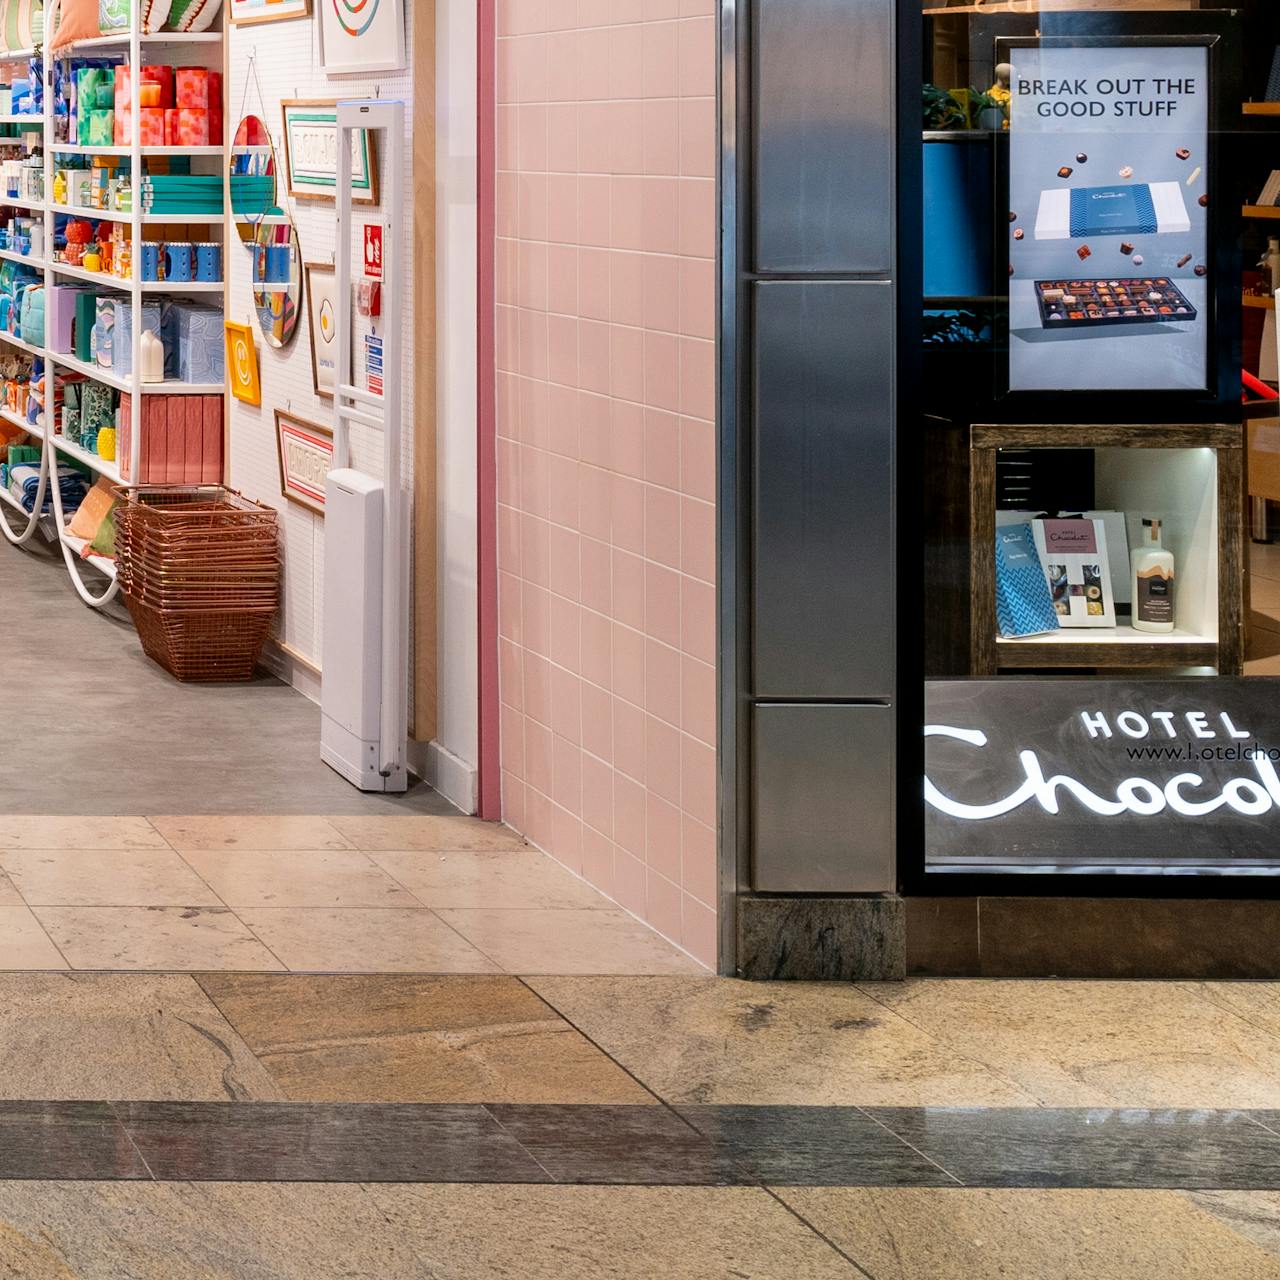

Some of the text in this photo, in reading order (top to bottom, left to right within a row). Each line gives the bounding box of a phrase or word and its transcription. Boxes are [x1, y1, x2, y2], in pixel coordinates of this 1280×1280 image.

[1017, 78, 1196, 96] BREAK OUT THE
[1037, 100, 1177, 117] GOOD STUFF
[1080, 711, 1251, 739] HOTEL
